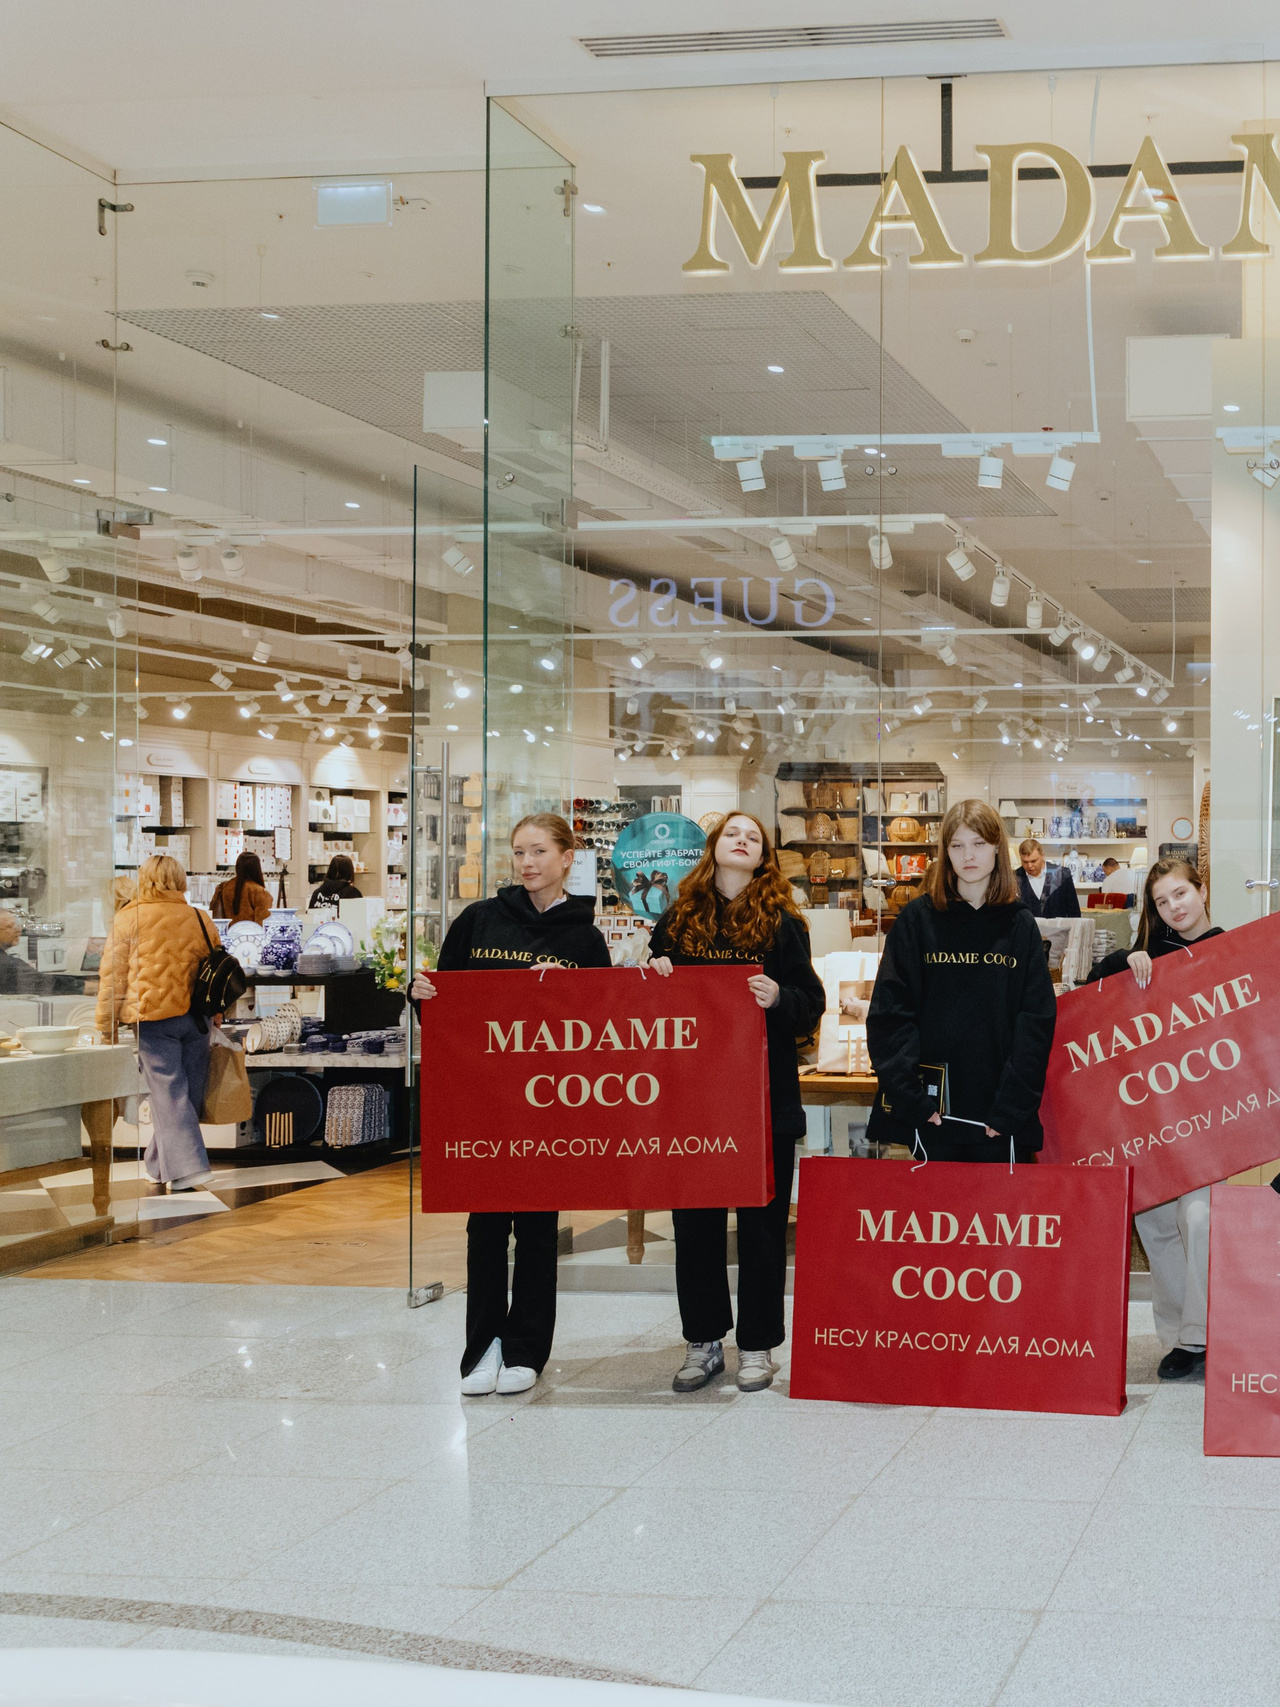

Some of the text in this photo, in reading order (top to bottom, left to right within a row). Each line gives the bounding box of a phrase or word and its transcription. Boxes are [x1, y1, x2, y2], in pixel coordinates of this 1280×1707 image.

[620, 849, 662, 859] УСПЕЙТЕ
[623, 859, 649, 868] СВОЙ
[470, 943, 532, 962] MADAME
[484, 1017, 699, 1053] MADAME
[1063, 973, 1260, 1073] MADAME
[1118, 1038, 1241, 1106] COCO
[525, 1073, 660, 1108] COCO
[1121, 1110, 1212, 1159] КРАСОТУ
[1221, 1092, 1260, 1125] ДЛЯ
[445, 1136, 738, 1159] НЕСУ КРАСОТУ ДЛЯ ДОМА
[856, 1209, 1062, 1248] MADAME
[892, 1265, 1022, 1303] COCO
[814, 1328, 1095, 1358] НЕСУ КРАСОТУ ДЛЯ ДОМА
